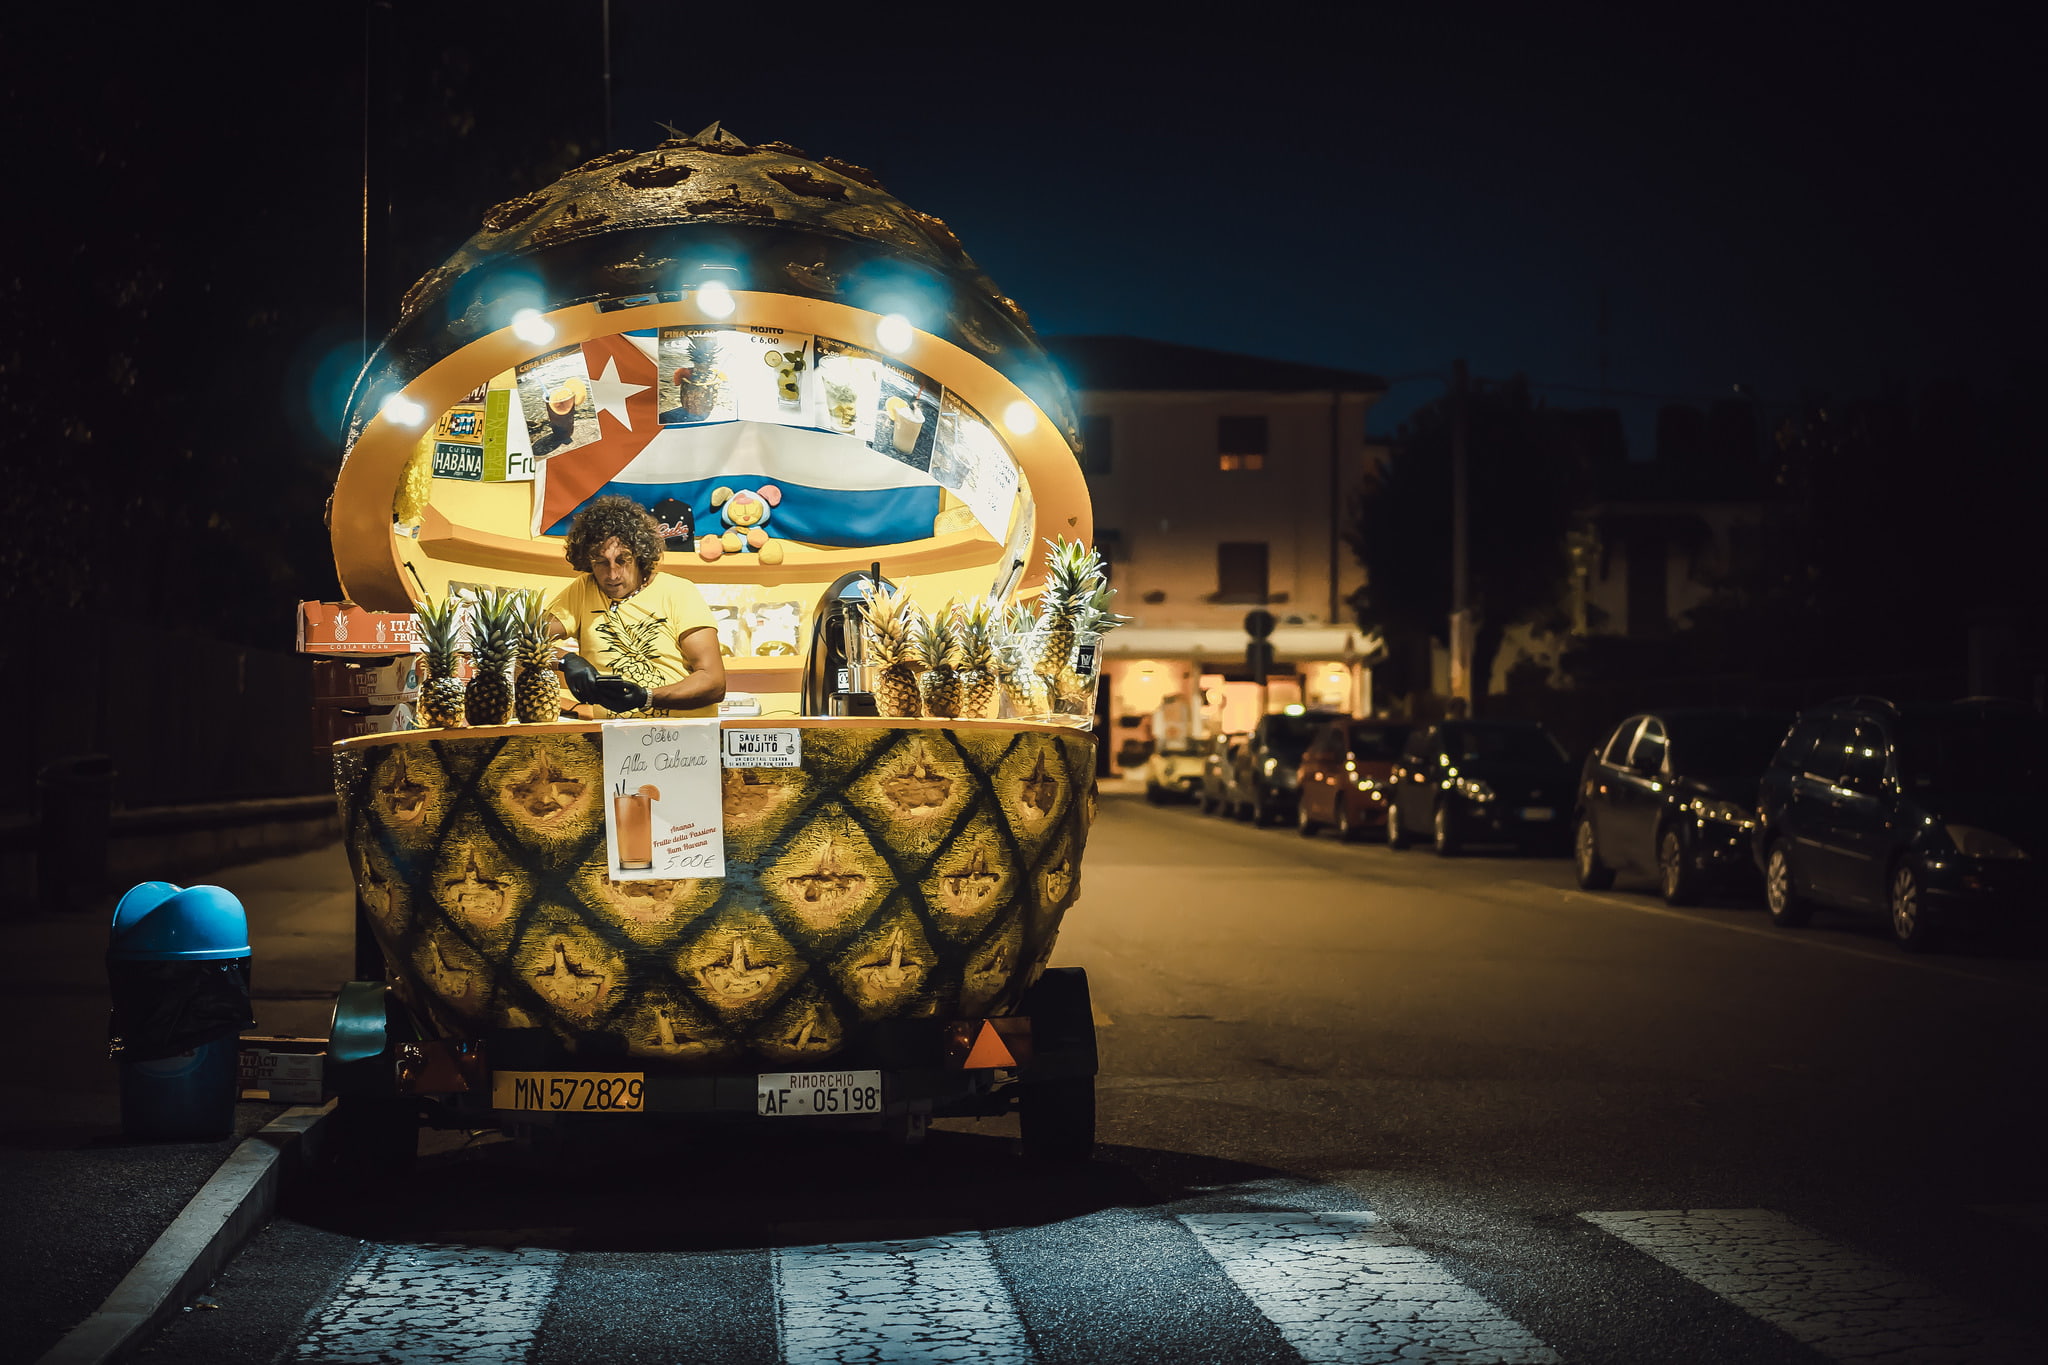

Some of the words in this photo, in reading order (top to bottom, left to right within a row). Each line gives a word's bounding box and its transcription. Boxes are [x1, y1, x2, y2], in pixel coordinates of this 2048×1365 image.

[750, 326, 784, 335] MOJITO
[759, 337, 779, 345] 6,00
[823, 348, 840, 357] 6,00
[519, 360, 540, 373] CUBA
[540, 352, 561, 365] LIBRE
[449, 446, 471, 454] CUBA
[435, 452, 482, 473] HABANA
[739, 733, 760, 742] SAVE
[763, 733, 778, 742] THE
[739, 742, 778, 753] MOJITO
[619, 752, 648, 775] Alla
[654, 749, 708, 772] Cubana
[670, 822, 695, 834] Ananas
[653, 838, 672, 848] Frutto
[672, 834, 689, 843] della
[688, 827, 717, 838] Passione
[682, 839, 708, 850] Havana
[790, 1074, 854, 1089] RIMORCHIO
[515, 1078, 545, 1110] MN
[550, 1078, 644, 1110] 572829
[765, 1089, 791, 1114] AF
[813, 1086, 877, 1112] 05198
